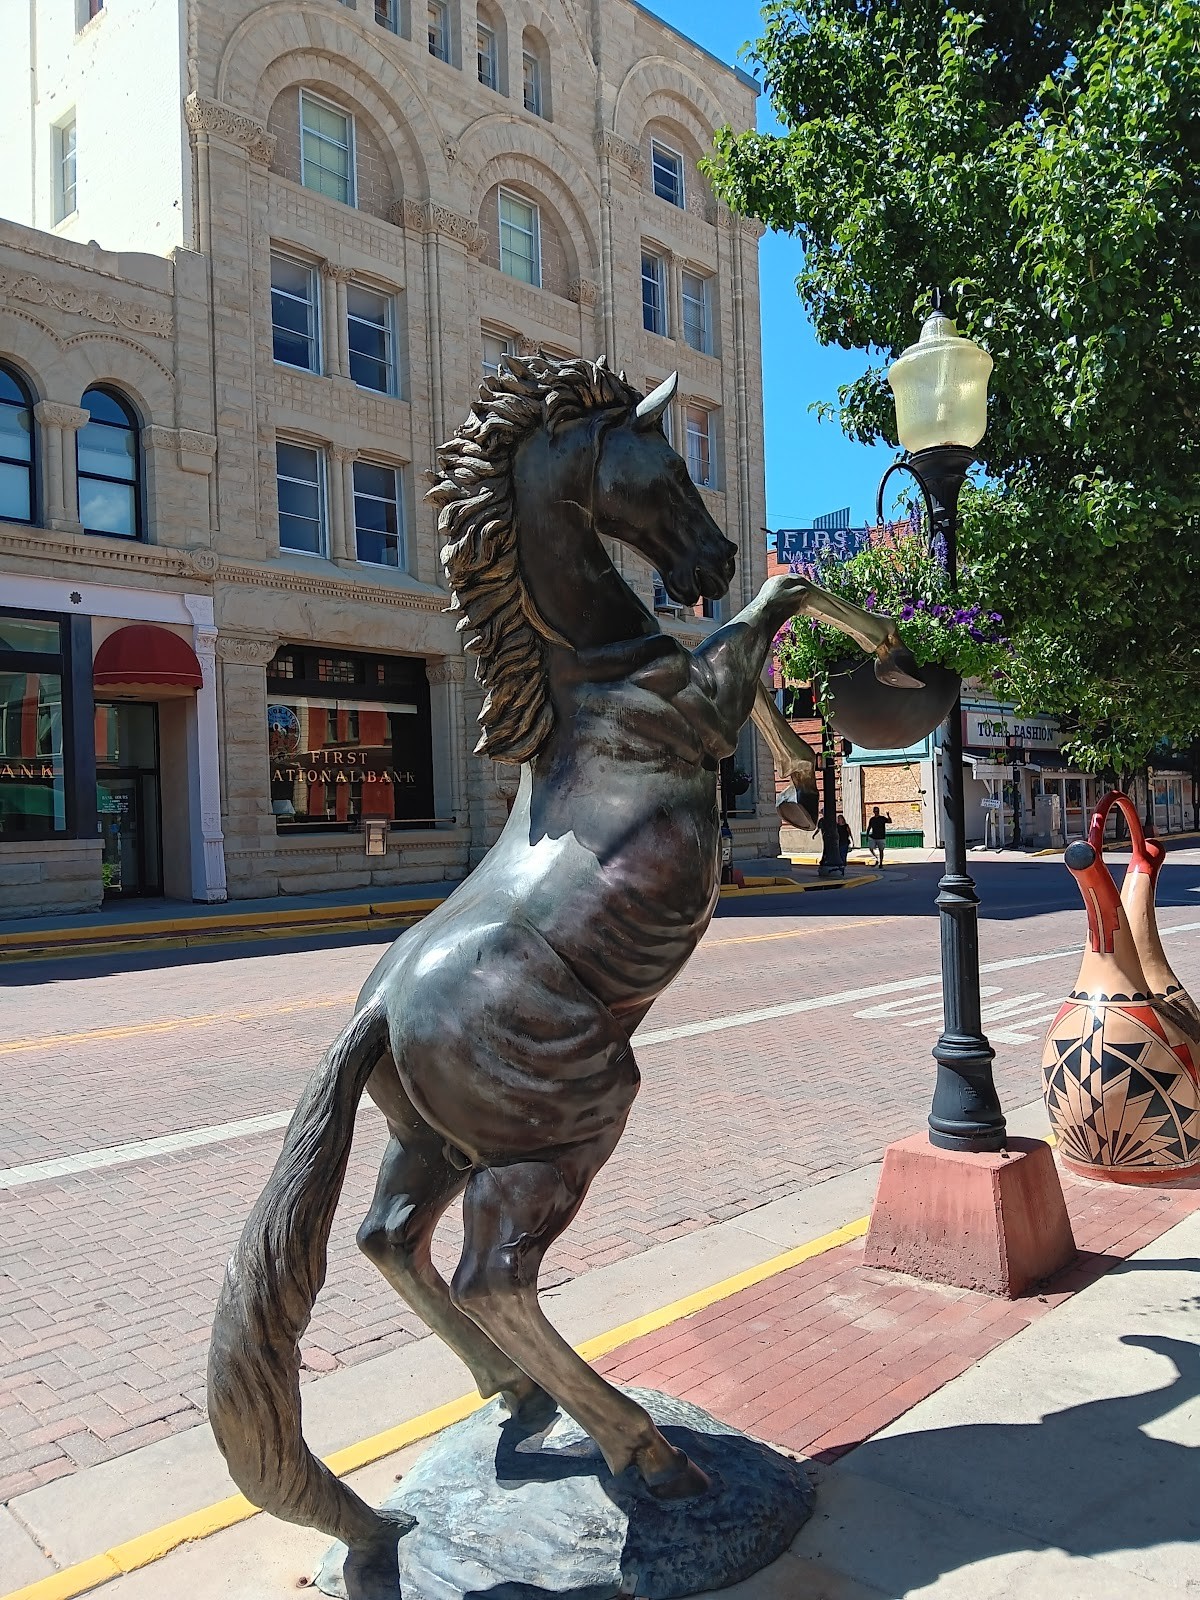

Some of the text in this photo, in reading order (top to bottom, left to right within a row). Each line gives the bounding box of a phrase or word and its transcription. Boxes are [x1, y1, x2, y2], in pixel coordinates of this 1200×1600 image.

[783, 530, 866, 549] FIRST
[311, 751, 368, 765] FIRST
[0, 764, 56, 779] ANK
[271, 769, 415, 783] ATIONAL BANK
